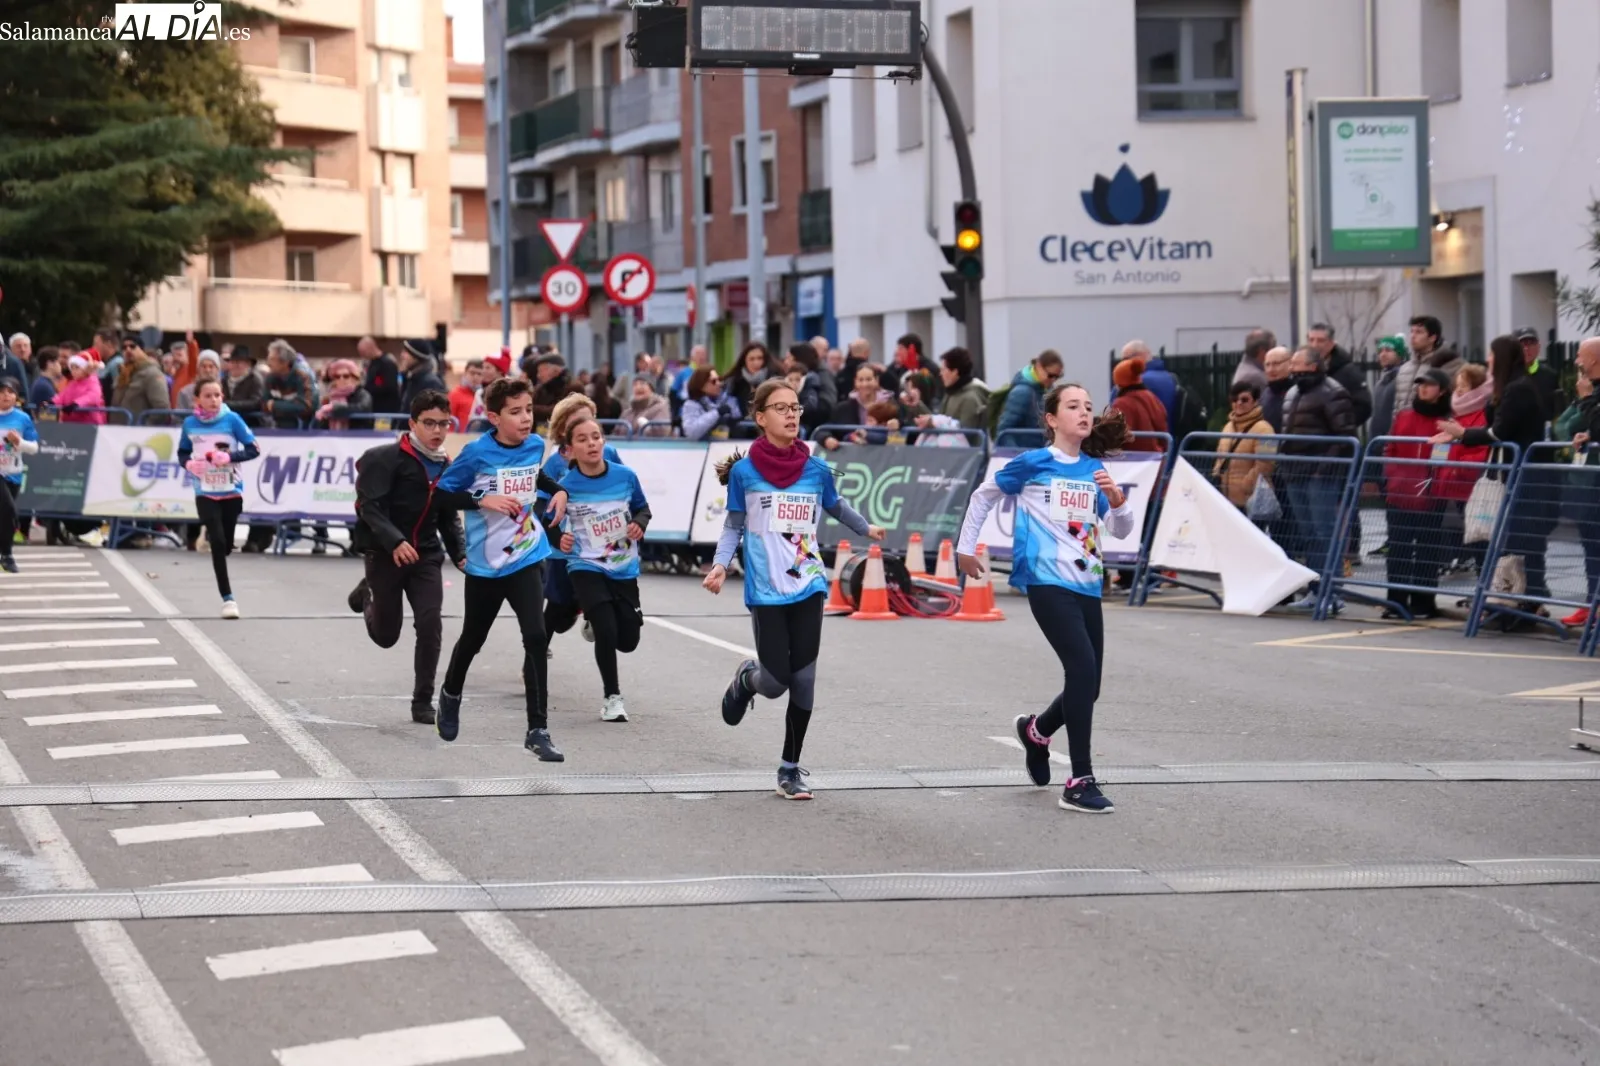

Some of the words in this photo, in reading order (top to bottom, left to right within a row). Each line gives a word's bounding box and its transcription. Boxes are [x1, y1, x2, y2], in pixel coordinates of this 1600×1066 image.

[1040, 235, 1213, 263] CleceVitam
[1074, 270, 1106, 285] San
[1112, 269, 1181, 284] Antonio
[552, 281, 577, 296] 30
[138, 461, 193, 488] SET
[504, 476, 532, 495] 6449
[825, 462, 912, 530] RG
[1060, 490, 1089, 509] 6410
[777, 503, 810, 521] 6506
[592, 515, 622, 537] 6473
